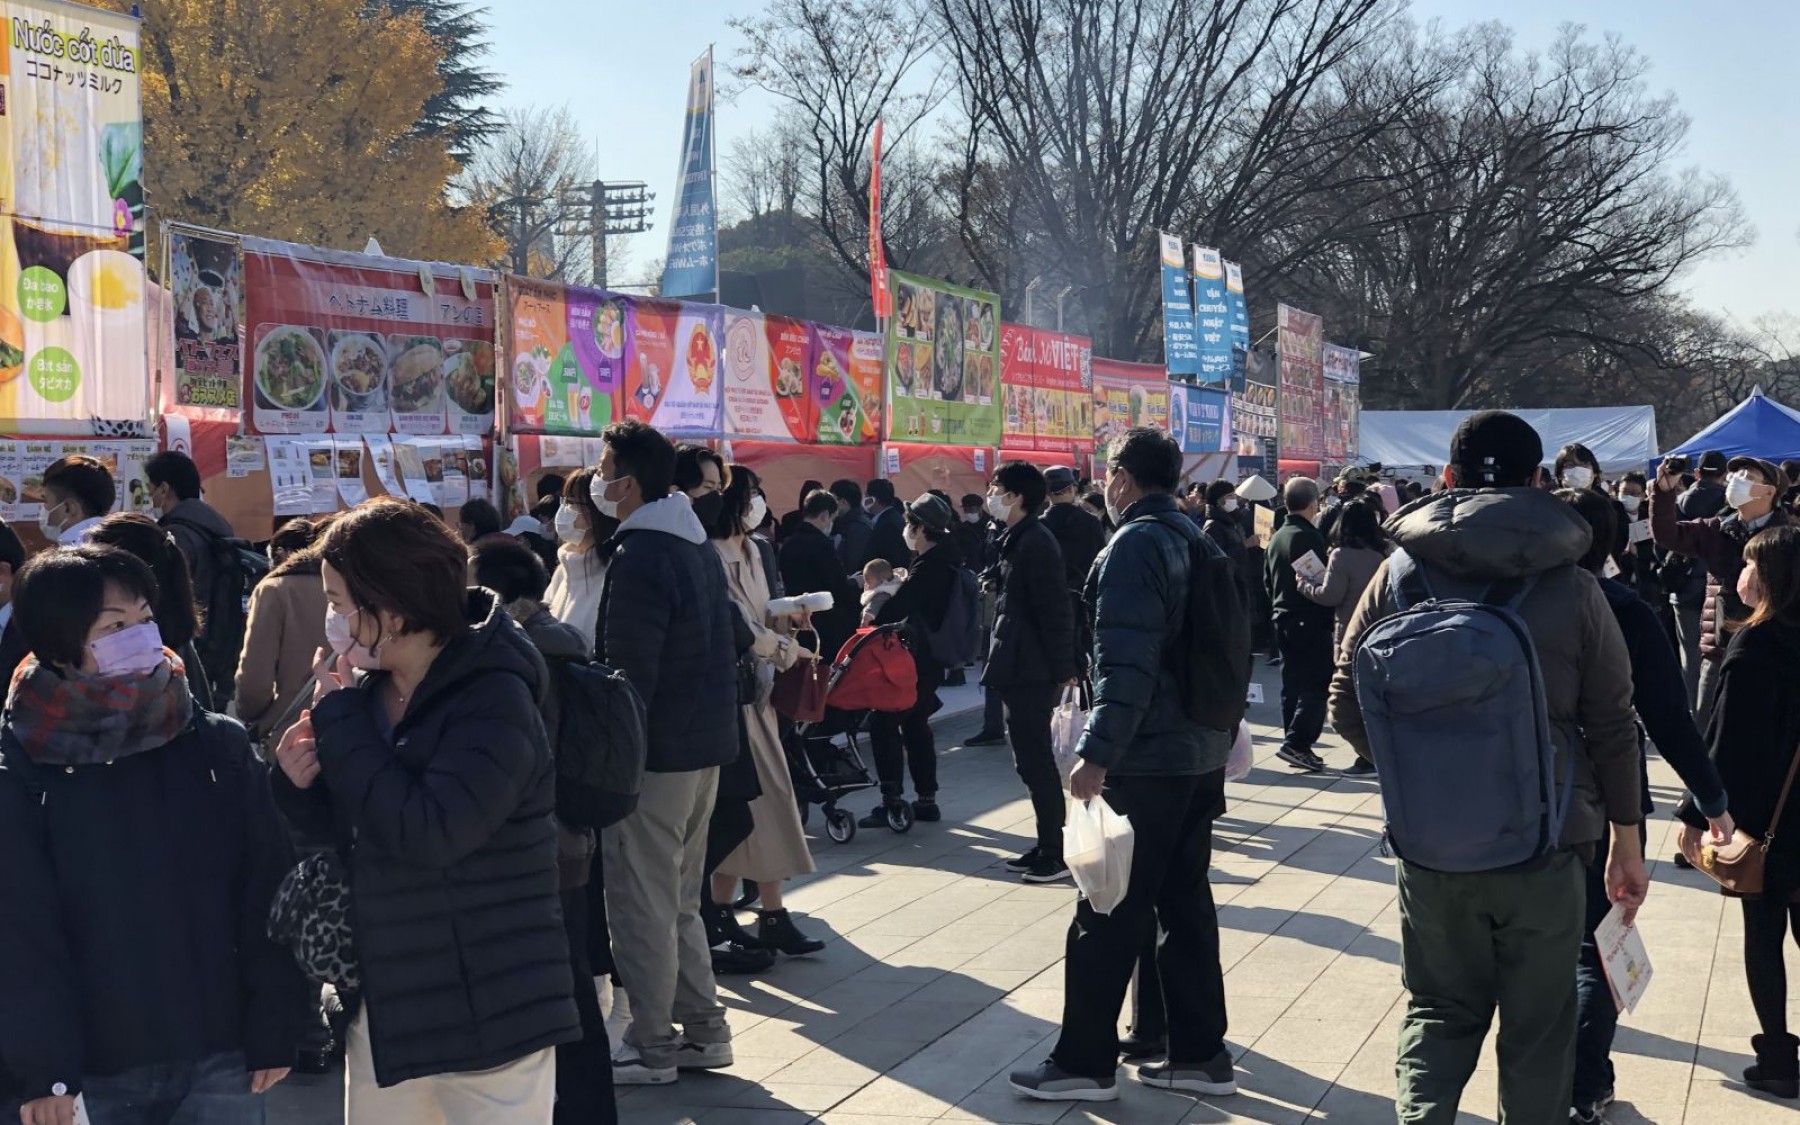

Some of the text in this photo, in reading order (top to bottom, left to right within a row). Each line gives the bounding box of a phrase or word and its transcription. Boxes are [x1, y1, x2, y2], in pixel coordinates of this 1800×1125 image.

[13, 17, 135, 73] Nước cốt dừa
[26, 60, 123, 94] ココナッツミルク
[1051, 334, 1079, 376] VIỆT
[38, 376, 72, 391] タピオカ
